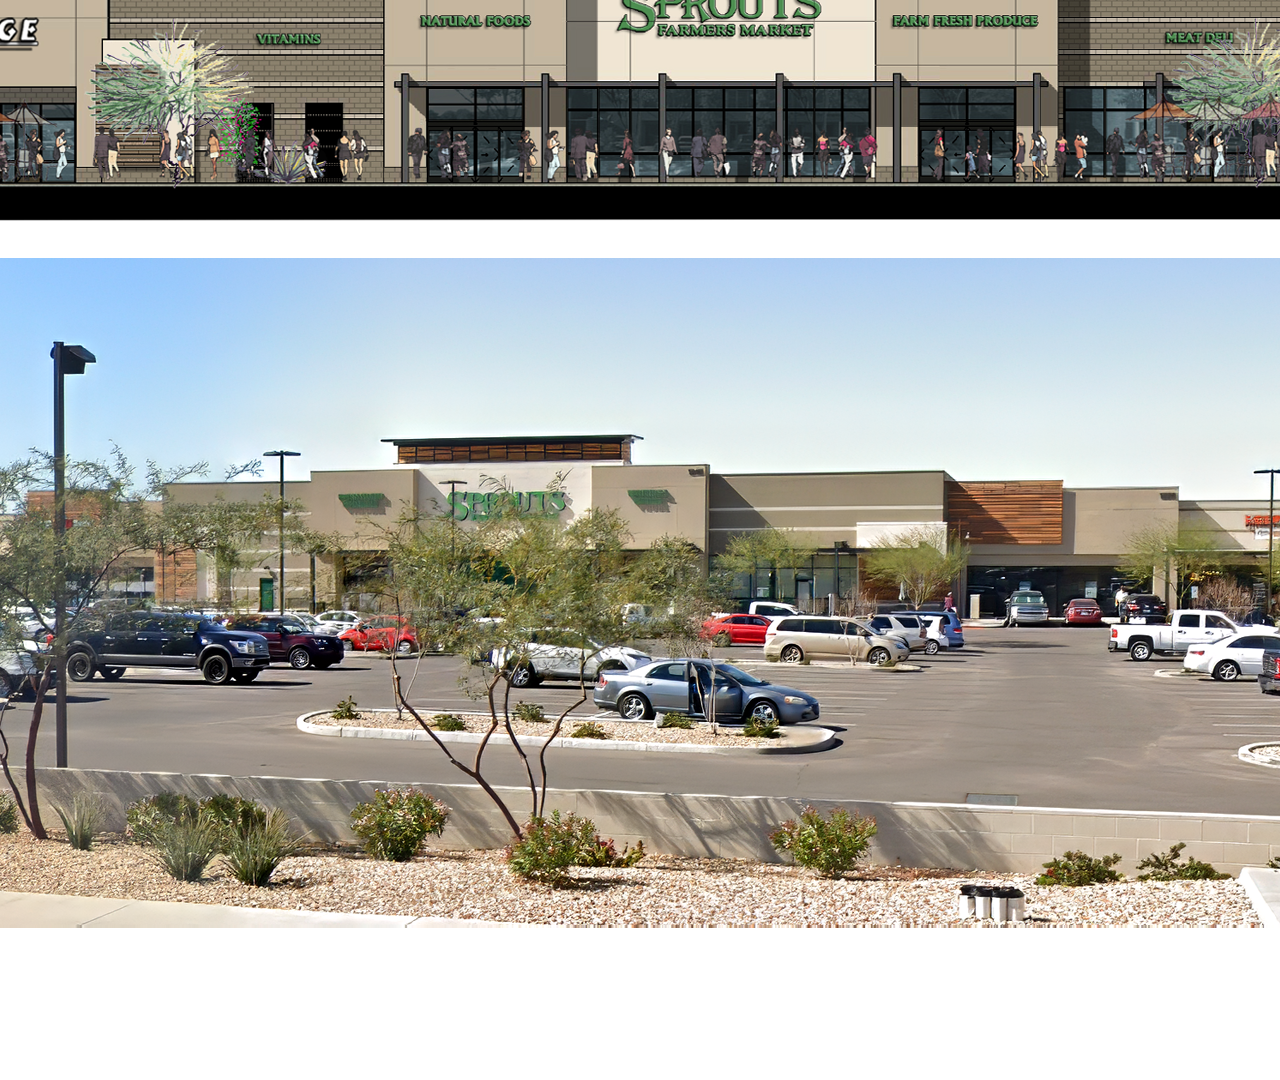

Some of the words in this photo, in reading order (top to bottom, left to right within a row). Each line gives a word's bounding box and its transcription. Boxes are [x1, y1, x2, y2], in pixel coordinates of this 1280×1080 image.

[420, 15, 482, 27] NATURAL
[486, 15, 531, 27] FOODS
[892, 14, 930, 27] FARM
[933, 14, 973, 27] FRESH
[976, 14, 1039, 27] PRODUCE
[657, 24, 736, 37] FARMERS
[740, 24, 814, 37] MARKET
[256, 33, 321, 45] VITAMINS
[1165, 32, 1203, 44] MEAT
[1205, 32, 1234, 44] DELI
[447, 491, 567, 521] SPRUTS
